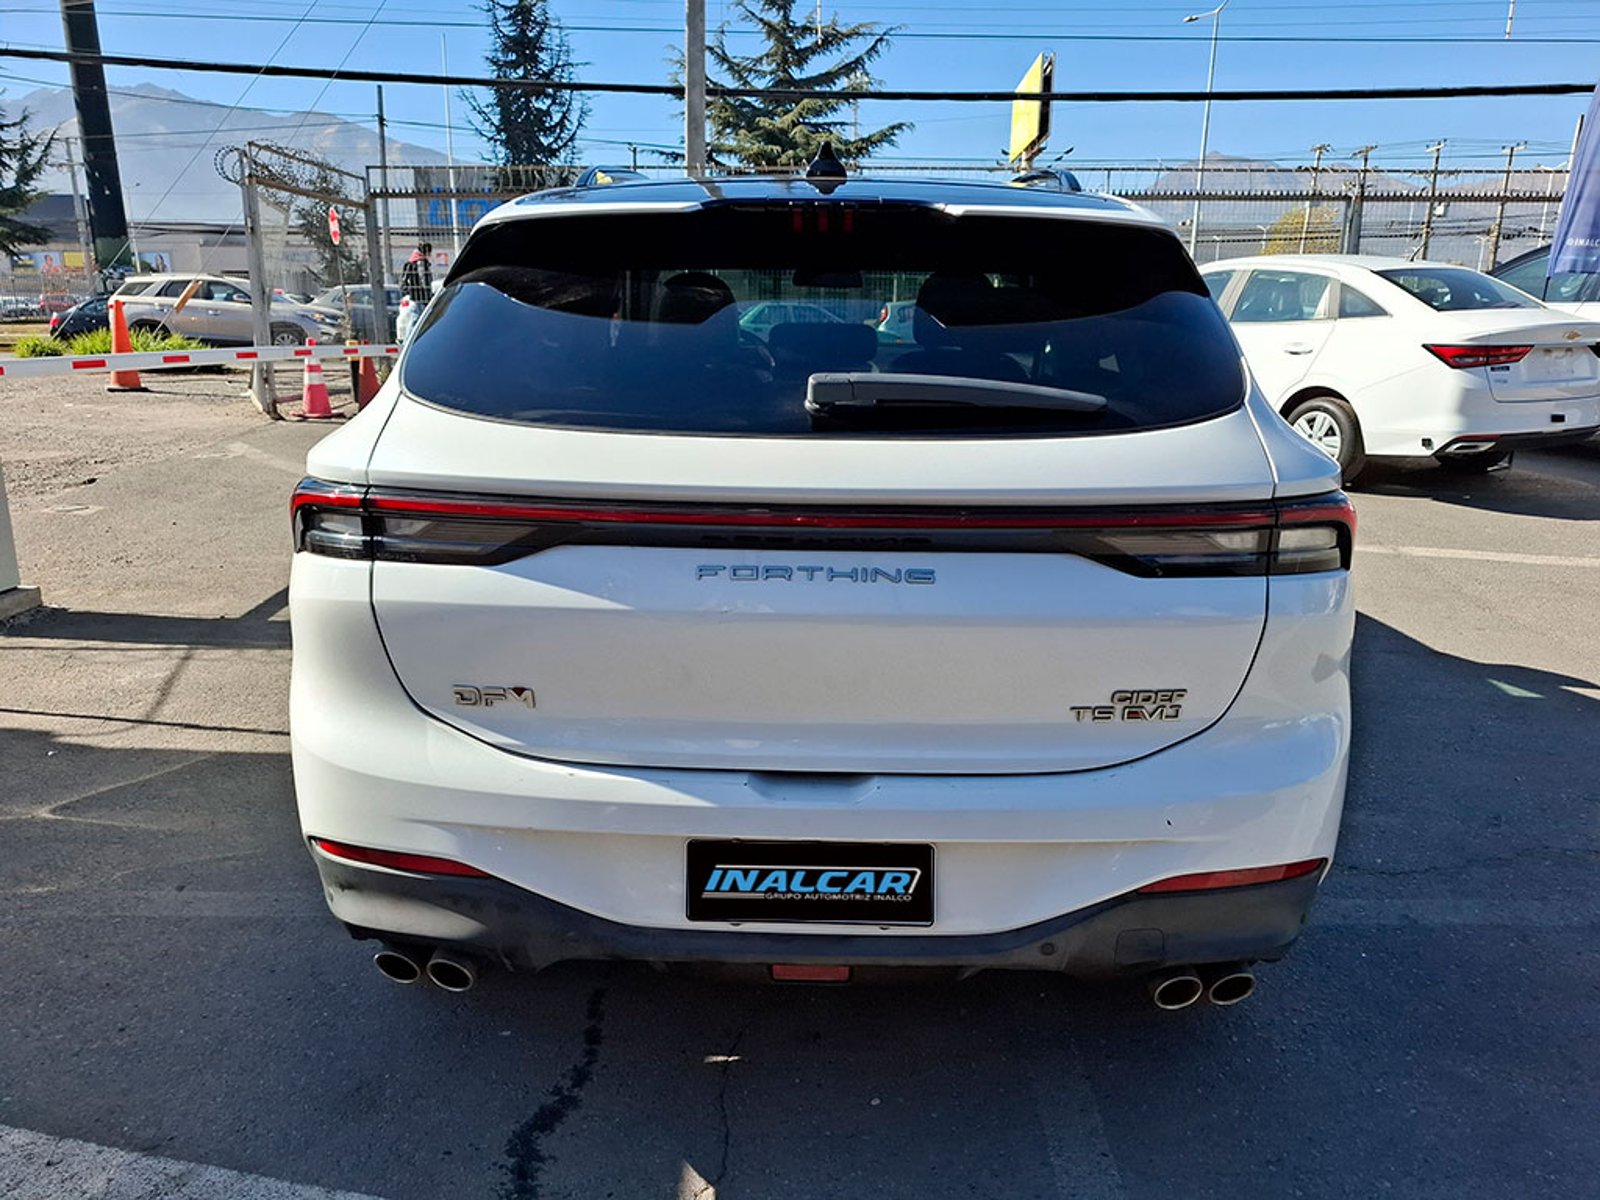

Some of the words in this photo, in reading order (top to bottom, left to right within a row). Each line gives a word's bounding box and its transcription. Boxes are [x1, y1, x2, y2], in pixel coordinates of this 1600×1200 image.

[695, 564, 936, 585] FORTHING
[452, 683, 536, 709] DFM
[1122, 704, 1182, 722] EVO
[704, 869, 912, 893] INALCAR
[765, 891, 802, 901] GRUPO
[804, 892, 871, 902] AUTOMOTRIZ
[873, 894, 913, 902] INALCO
